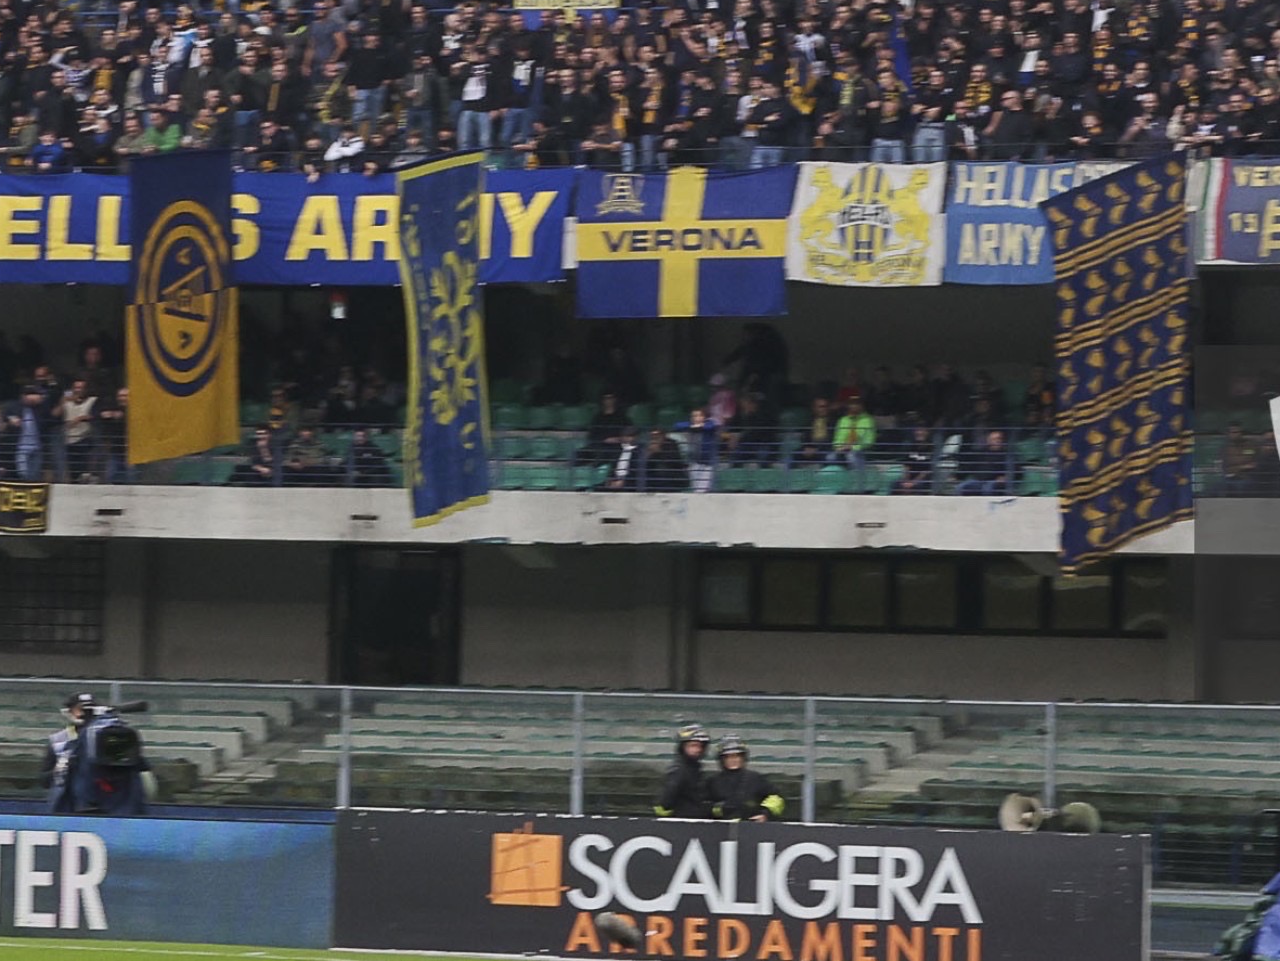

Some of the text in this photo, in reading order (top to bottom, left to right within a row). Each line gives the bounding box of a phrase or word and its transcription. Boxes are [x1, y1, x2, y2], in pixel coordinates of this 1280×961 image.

[285, 190, 559, 262] ARY
[601, 226, 765, 253] VERONA
[958, 222, 1047, 266] ARMY
[566, 833, 984, 925] SCALIGERA
